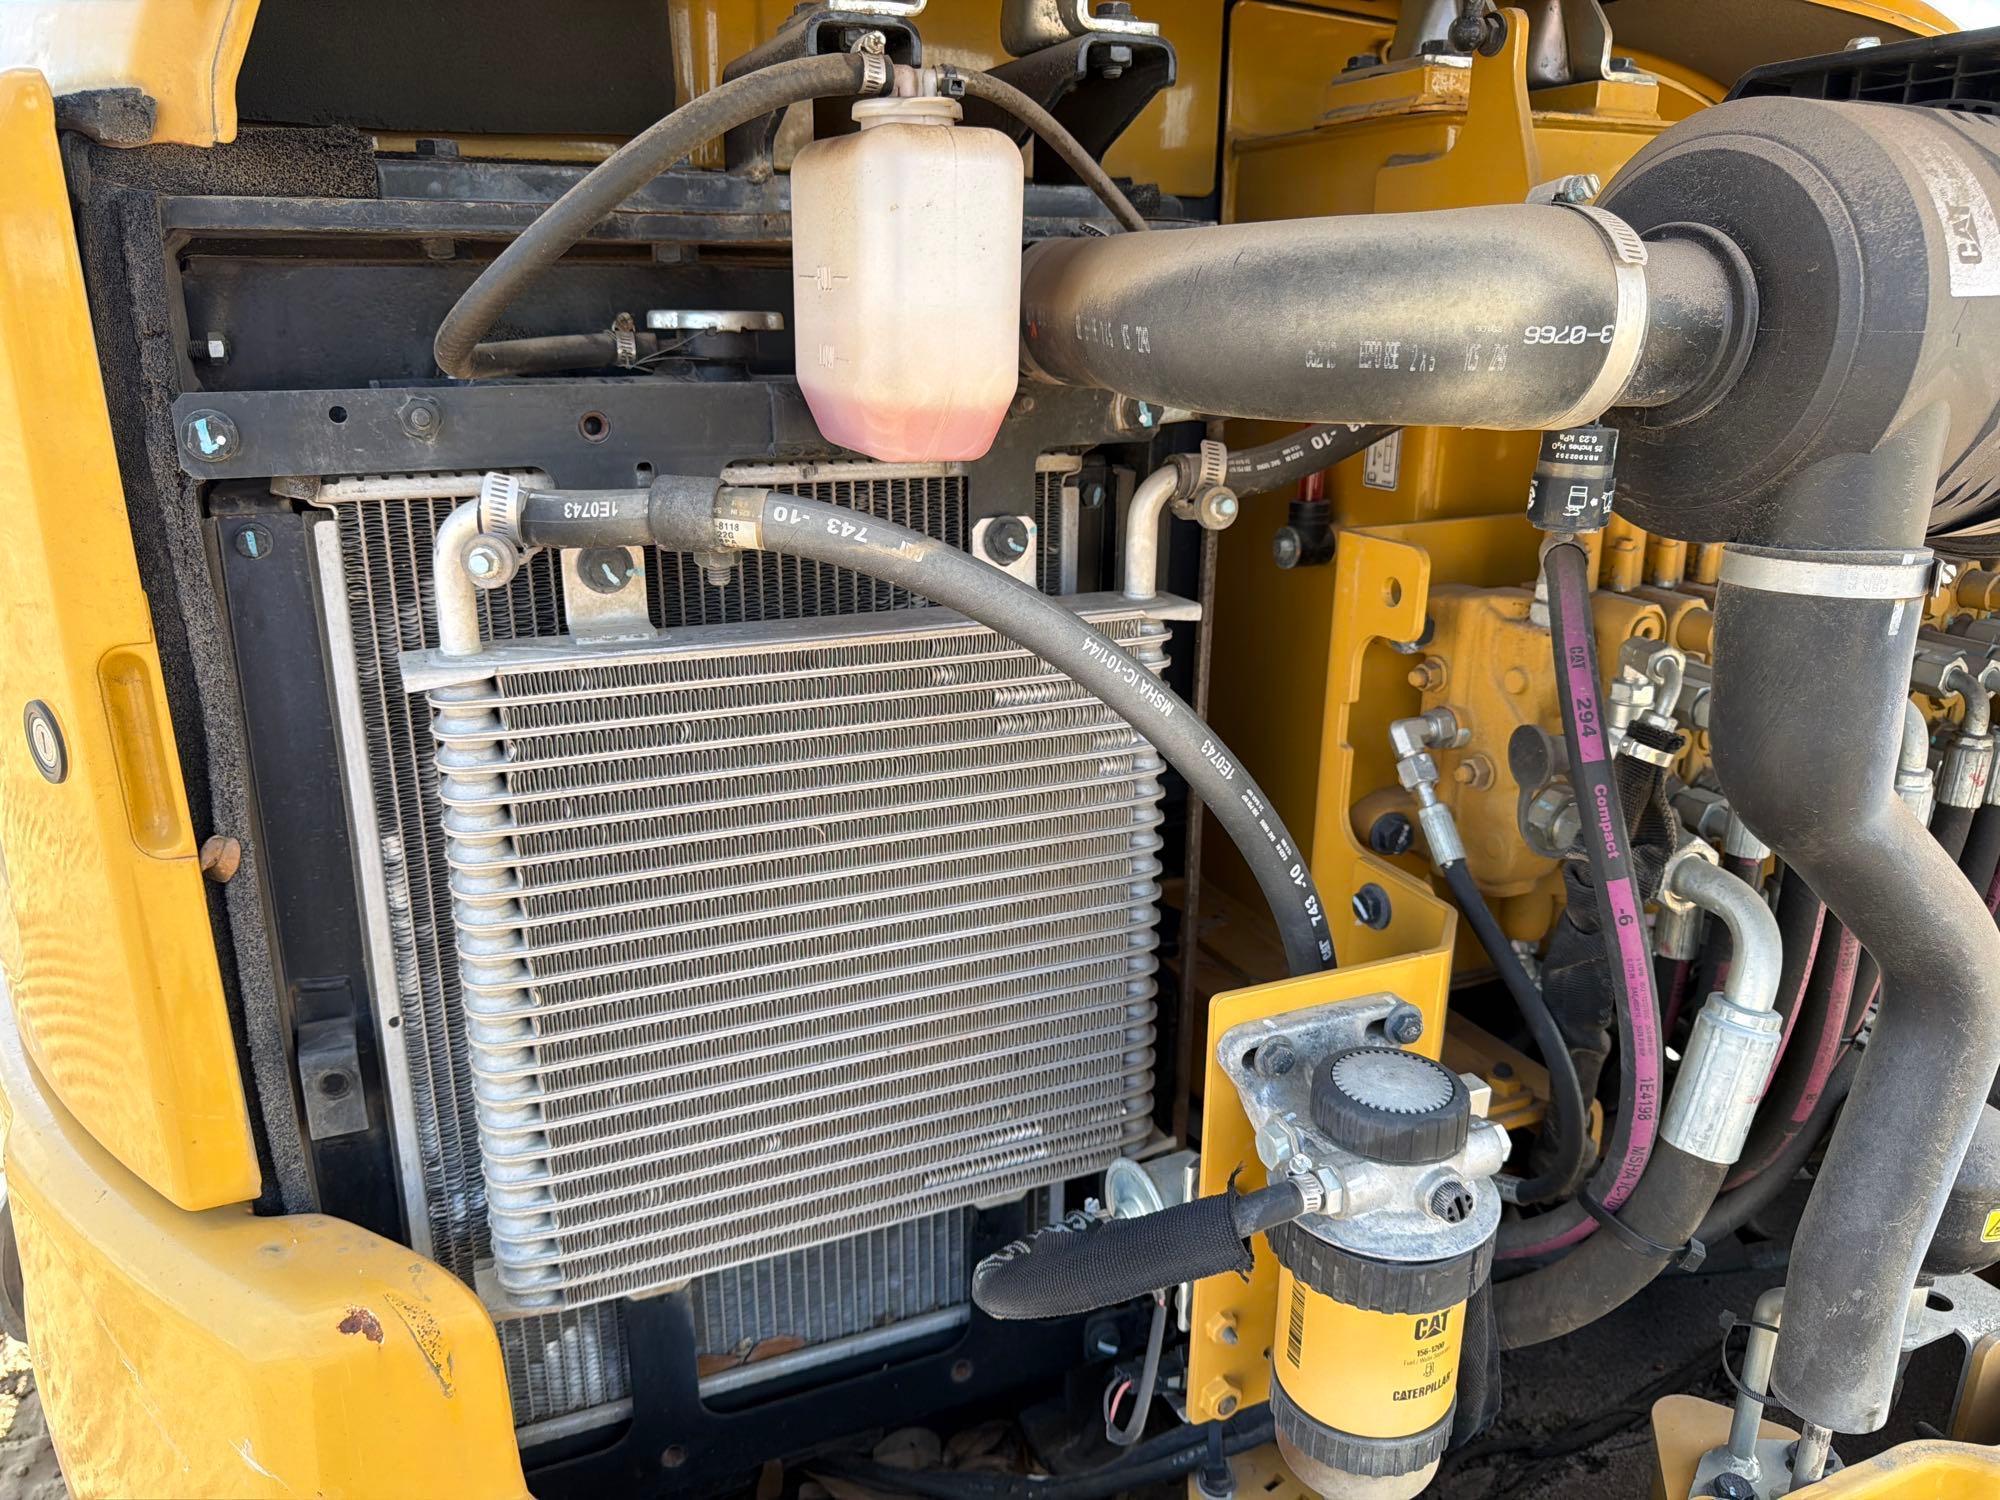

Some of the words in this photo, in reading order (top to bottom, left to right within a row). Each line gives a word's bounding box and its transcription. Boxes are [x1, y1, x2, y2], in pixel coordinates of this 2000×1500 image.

[1310, 430, 1337, 450] -10
[1559, 434, 1575, 443] kPa
[1578, 435, 1598, 444] 6.23
[1594, 445, 1604, 453] 25
[563, 501, 619, 519] 1E0743
[773, 506, 810, 524] -10
[827, 517, 868, 544] 743
[1081, 636, 1140, 688] IC-101/44
[1569, 645, 1586, 671] CAT
[1139, 678, 1175, 718] MSHA
[1577, 697, 1598, 738] 294
[1200, 739, 1236, 781] 1E0743
[1593, 784, 1620, 859] Compact
[1289, 863, 1307, 889] -10
[1304, 894, 1323, 927] 743
[1619, 908, 1634, 927] -6
[1637, 1077, 1655, 1122] 1E4198
[1622, 1145, 1647, 1182] MSHA
[1414, 1309, 1451, 1341] CAT
[1393, 1371, 1451, 1401] CATERPILLAR
